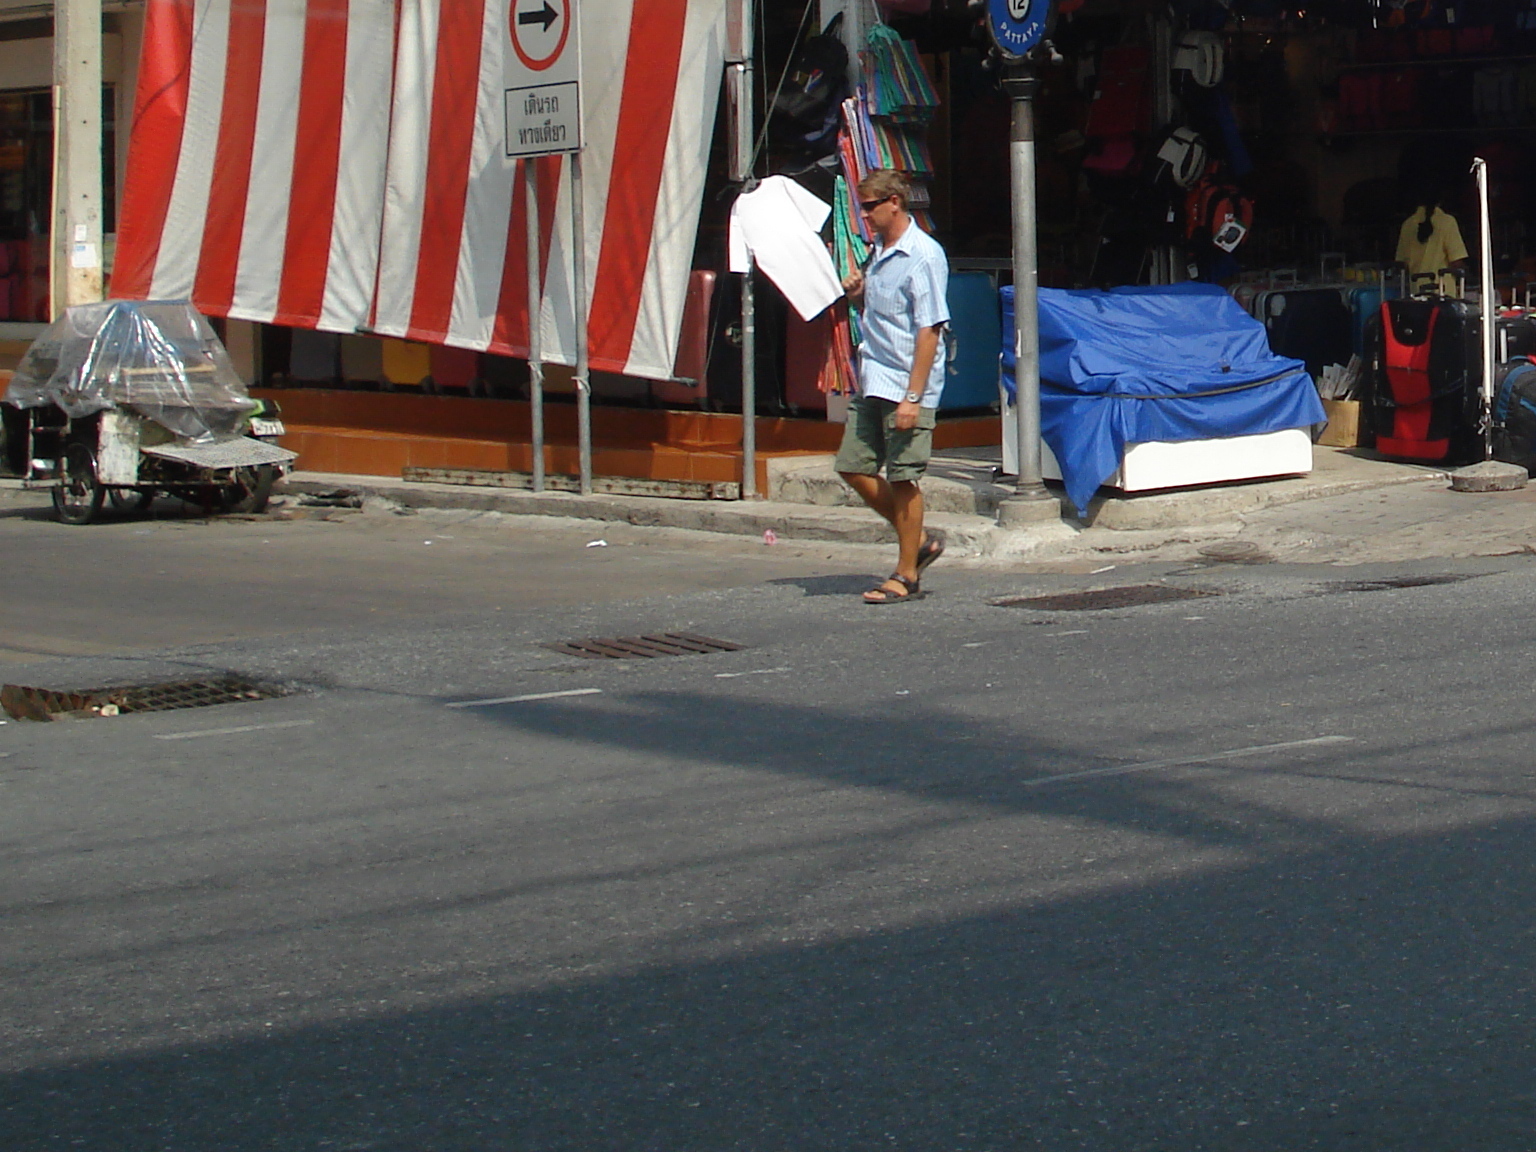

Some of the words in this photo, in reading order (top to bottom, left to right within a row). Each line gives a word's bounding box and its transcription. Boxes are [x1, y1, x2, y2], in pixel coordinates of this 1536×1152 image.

[1001, 21, 1039, 44] PATTAYA
[524, 93, 559, 116] เดินรถ
[519, 119, 566, 146] ทางเดียว
